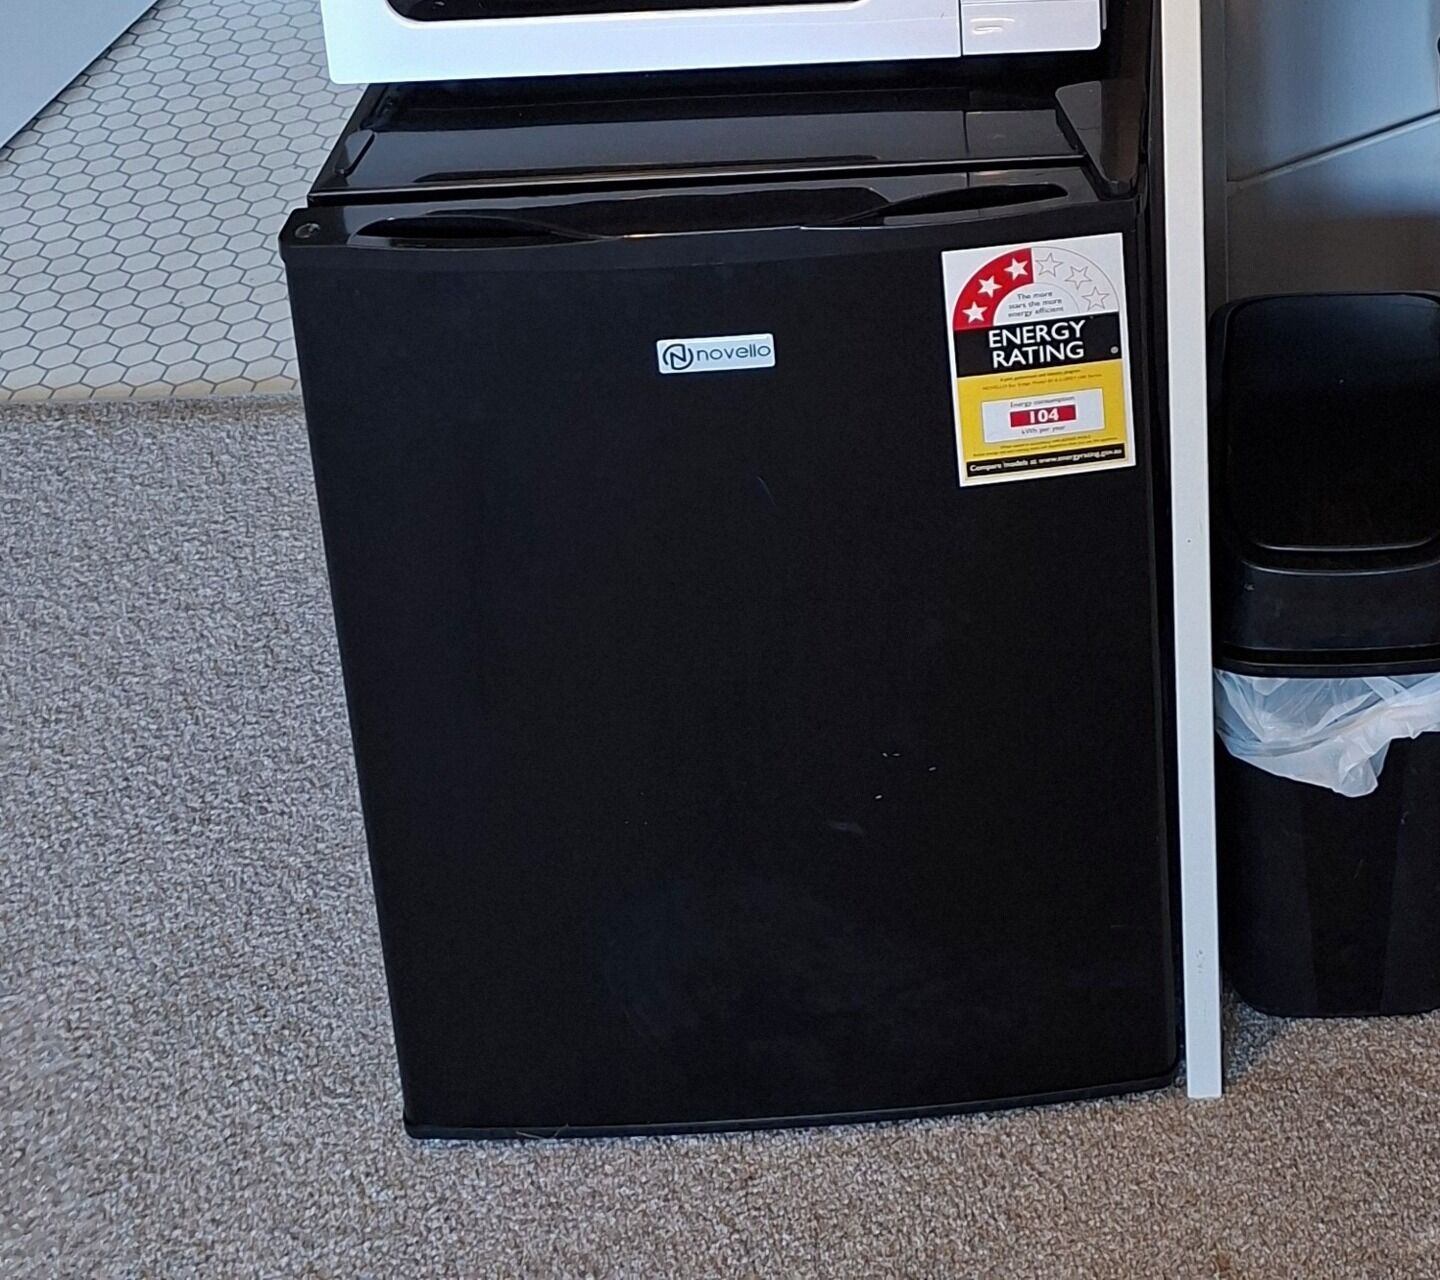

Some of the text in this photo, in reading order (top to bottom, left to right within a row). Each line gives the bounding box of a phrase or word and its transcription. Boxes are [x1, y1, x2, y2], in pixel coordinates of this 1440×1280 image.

[988, 319, 1086, 348] ENERGY
[696, 344, 771, 361] novello
[992, 341, 1085, 368] RATING
[1029, 408, 1060, 423] 104
[969, 462, 1003, 472] Compare
[1004, 459, 1029, 468] models
